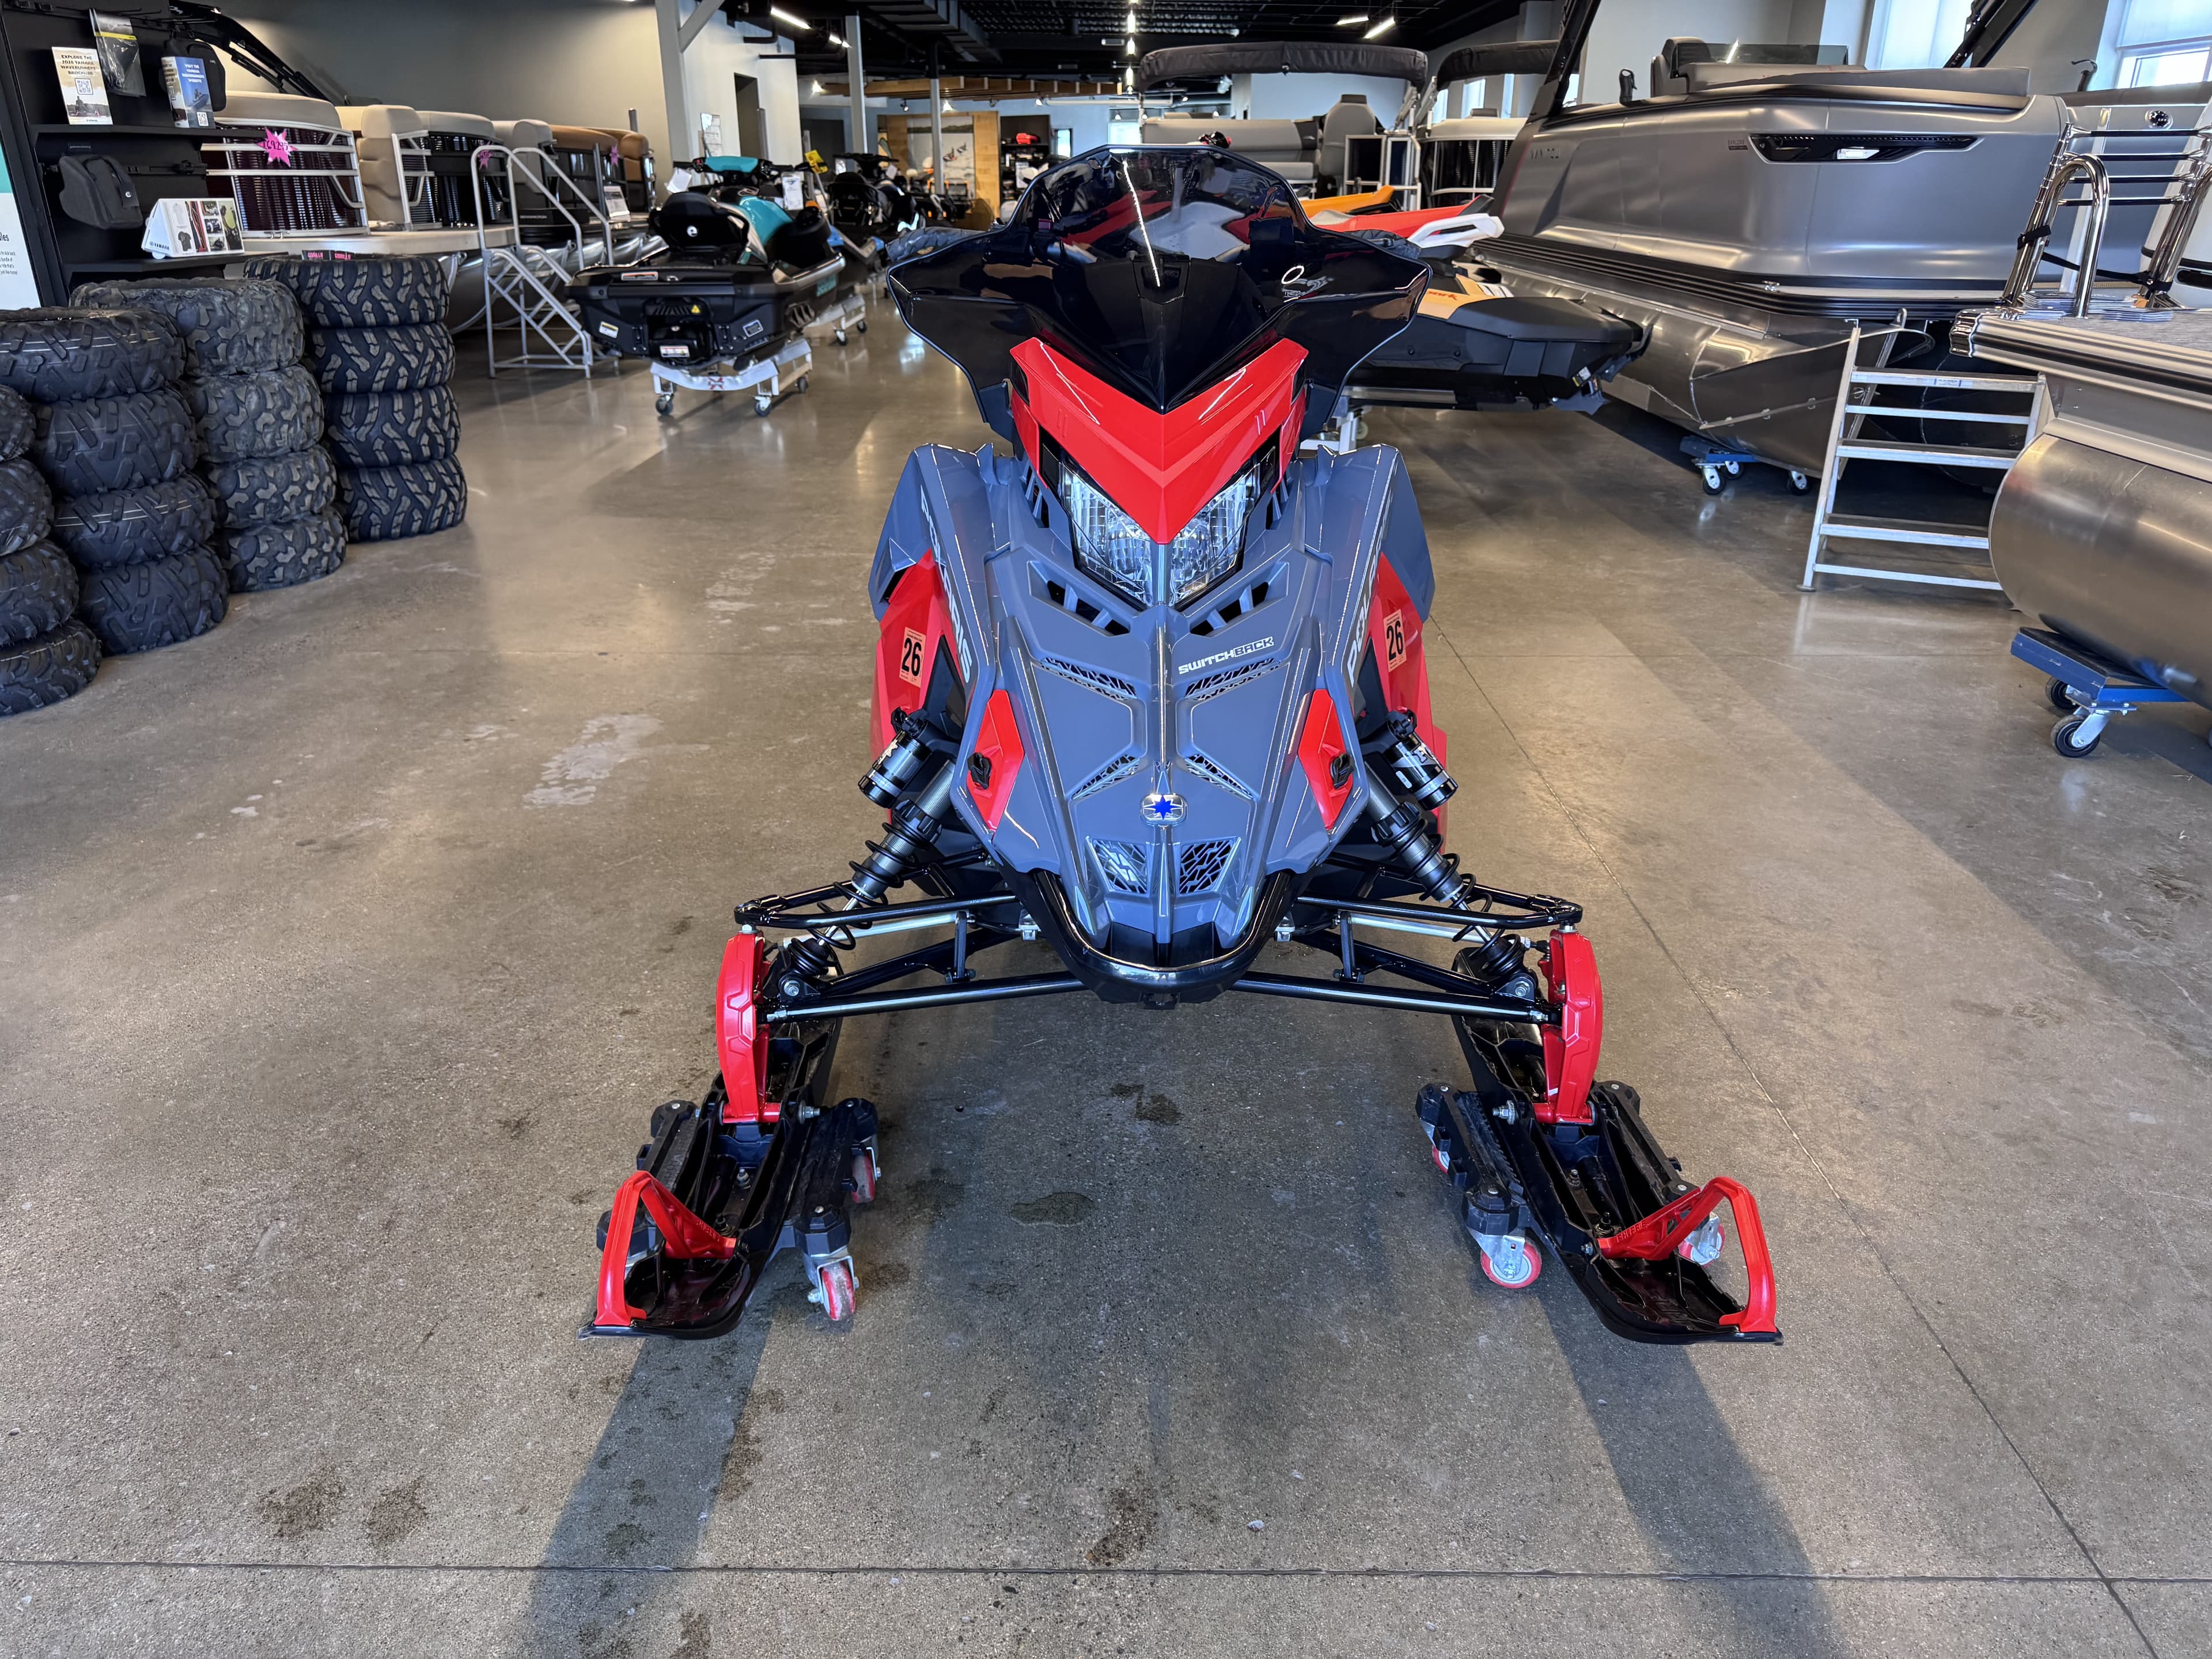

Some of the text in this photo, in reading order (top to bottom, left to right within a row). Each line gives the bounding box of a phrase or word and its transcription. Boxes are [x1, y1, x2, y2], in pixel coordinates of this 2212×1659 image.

[921, 484, 972, 684] POLARIS
[1346, 488, 1394, 688] POLARIS
[902, 637, 922, 676] 26
[1178, 636, 1274, 675] SWITCHBACK
[1387, 620, 1403, 661] 26
